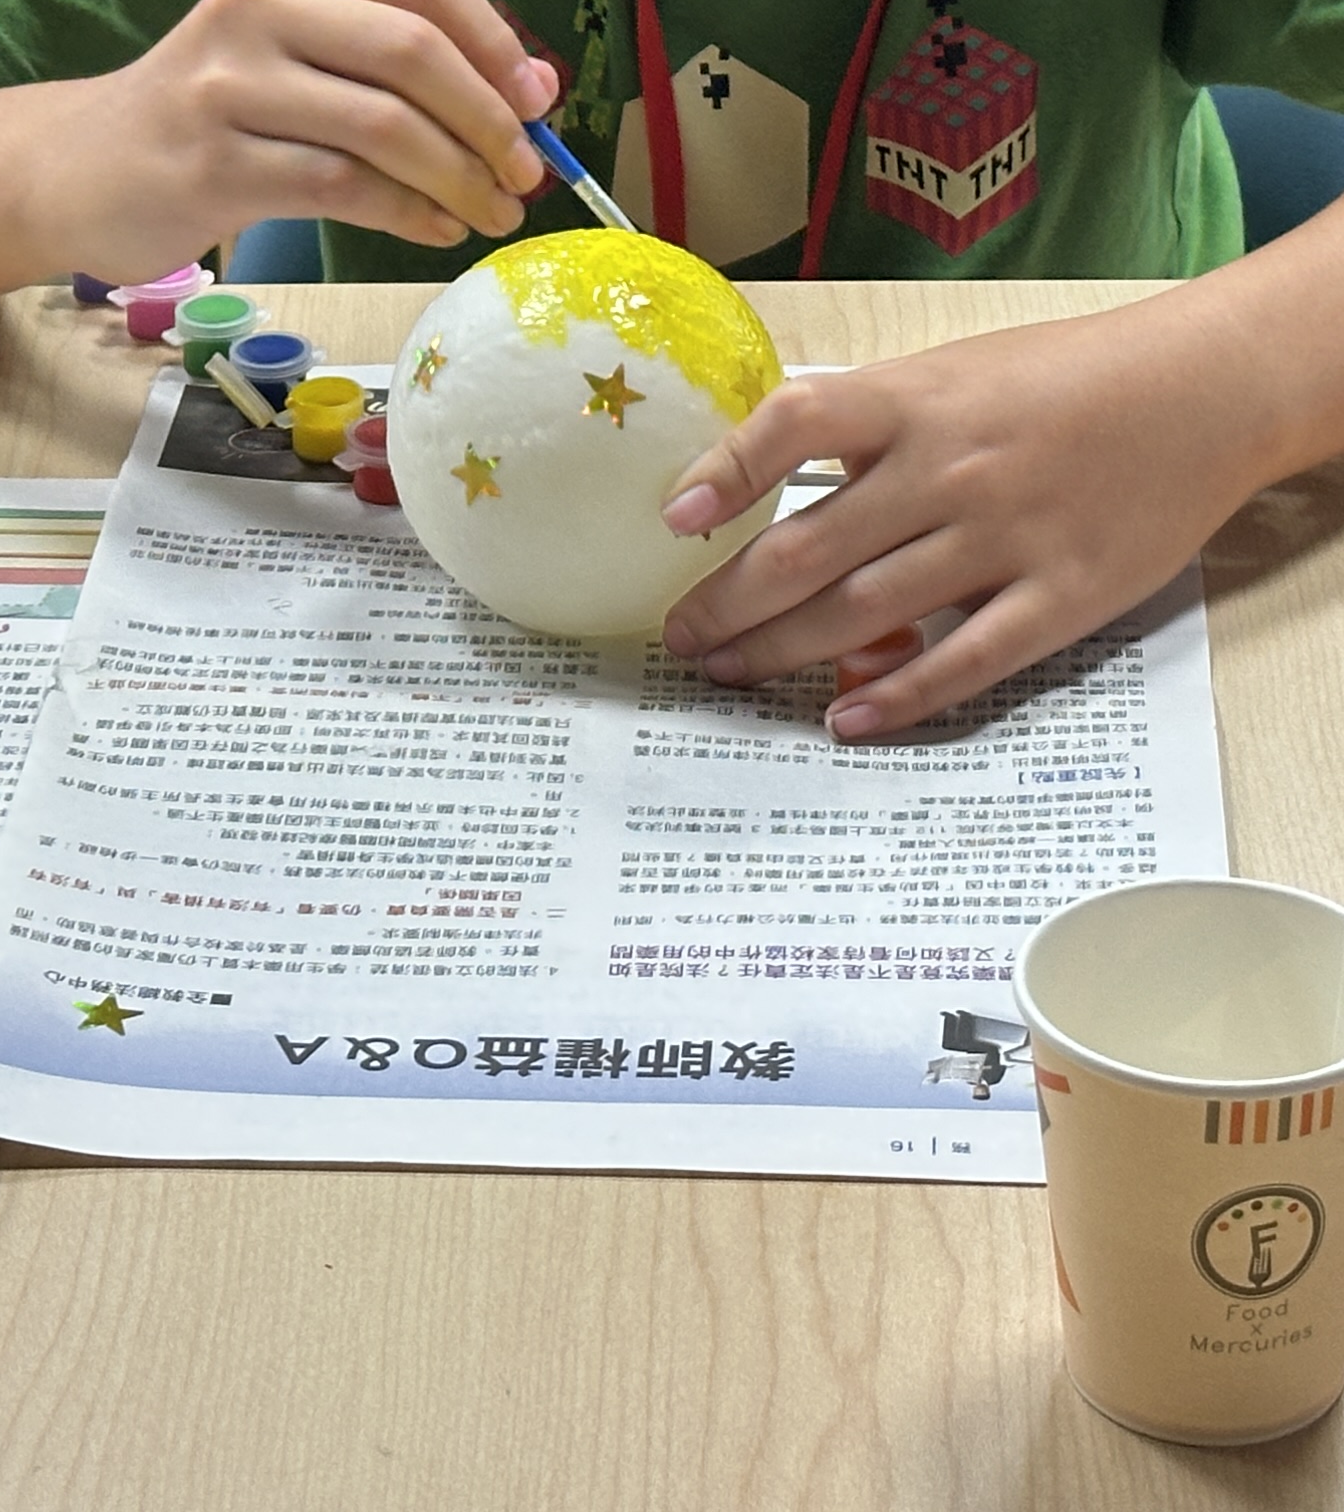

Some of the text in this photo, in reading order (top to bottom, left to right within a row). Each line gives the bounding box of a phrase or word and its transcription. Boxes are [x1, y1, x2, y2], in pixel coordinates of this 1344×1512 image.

[875, 129, 1032, 201] TNT TNT
[890, 1140, 916, 1152] 16
[1225, 1300, 1290, 1322] Food
[1188, 1324, 1313, 1354] Mercuries
